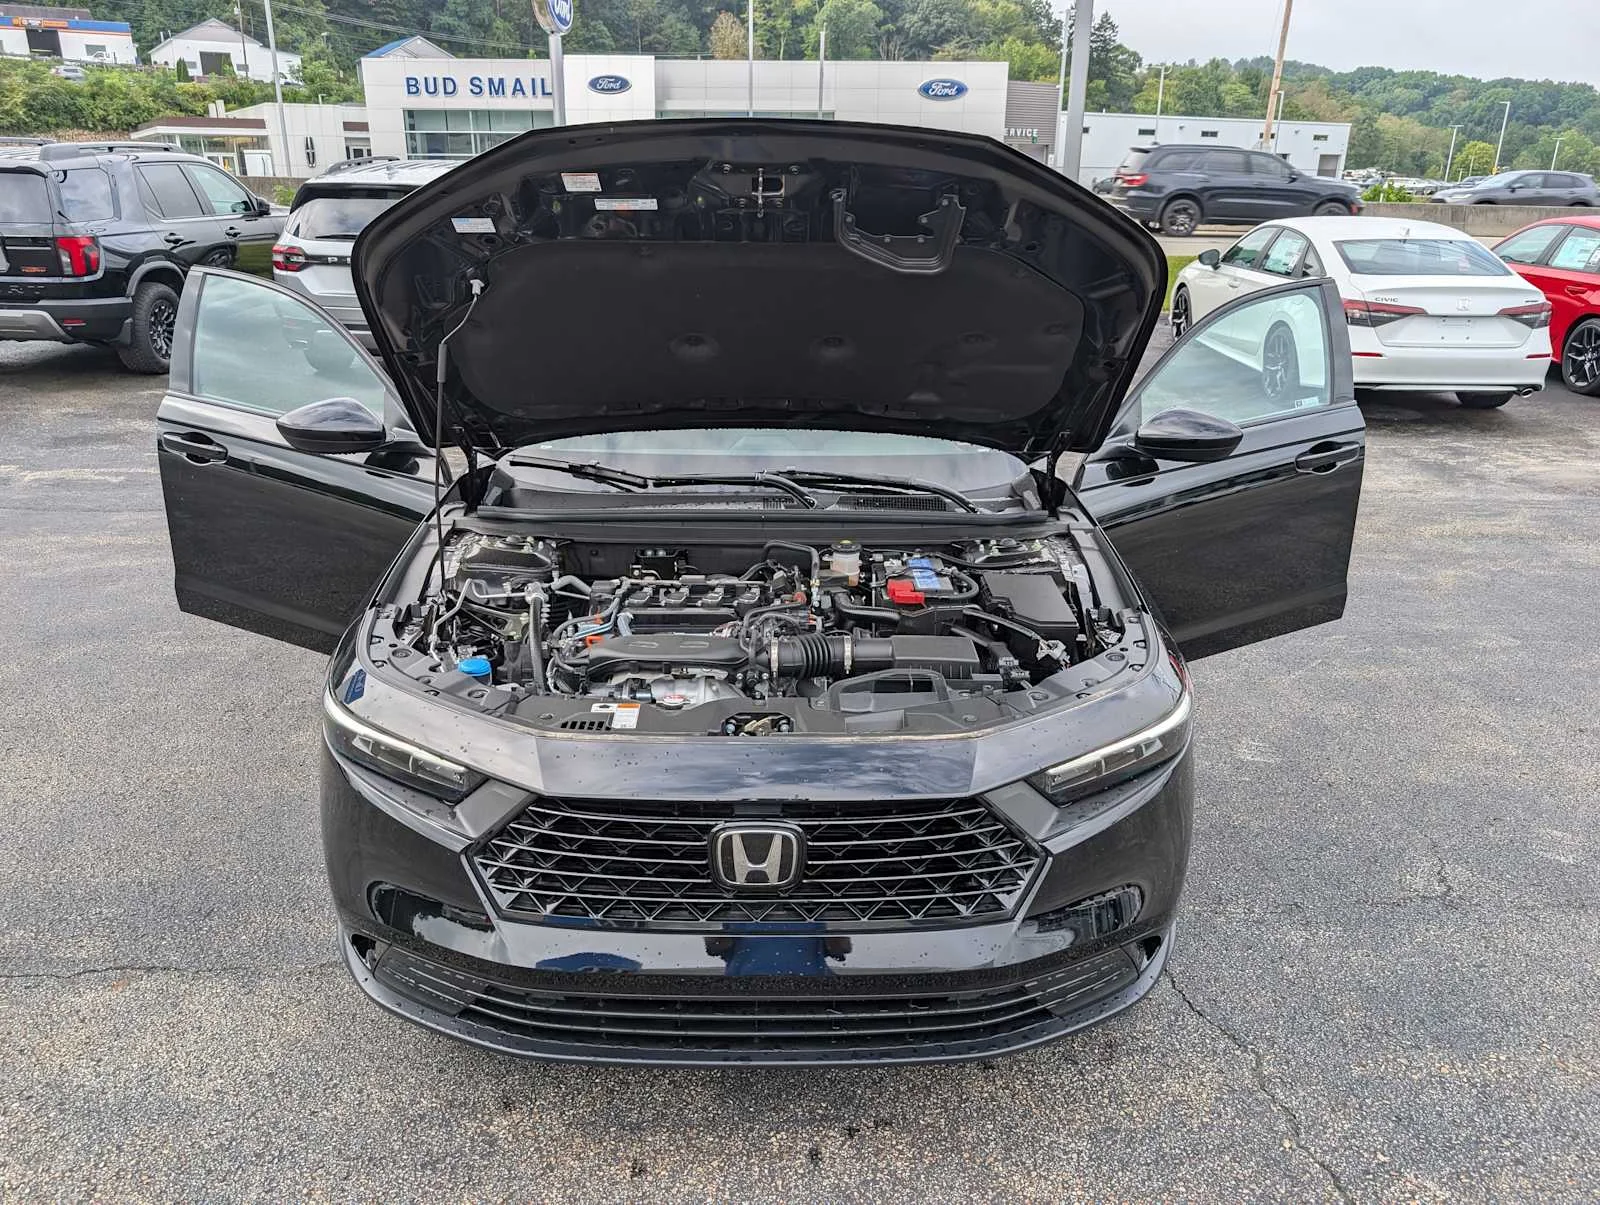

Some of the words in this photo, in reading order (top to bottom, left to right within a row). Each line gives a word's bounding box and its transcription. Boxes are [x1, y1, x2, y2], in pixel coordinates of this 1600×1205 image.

[405, 76, 457, 96] BUD
[469, 76, 553, 97] SMAIL
[596, 77, 621, 90] Ford
[928, 81, 958, 96] Ford
[1003, 127, 1039, 138] ERVICE
